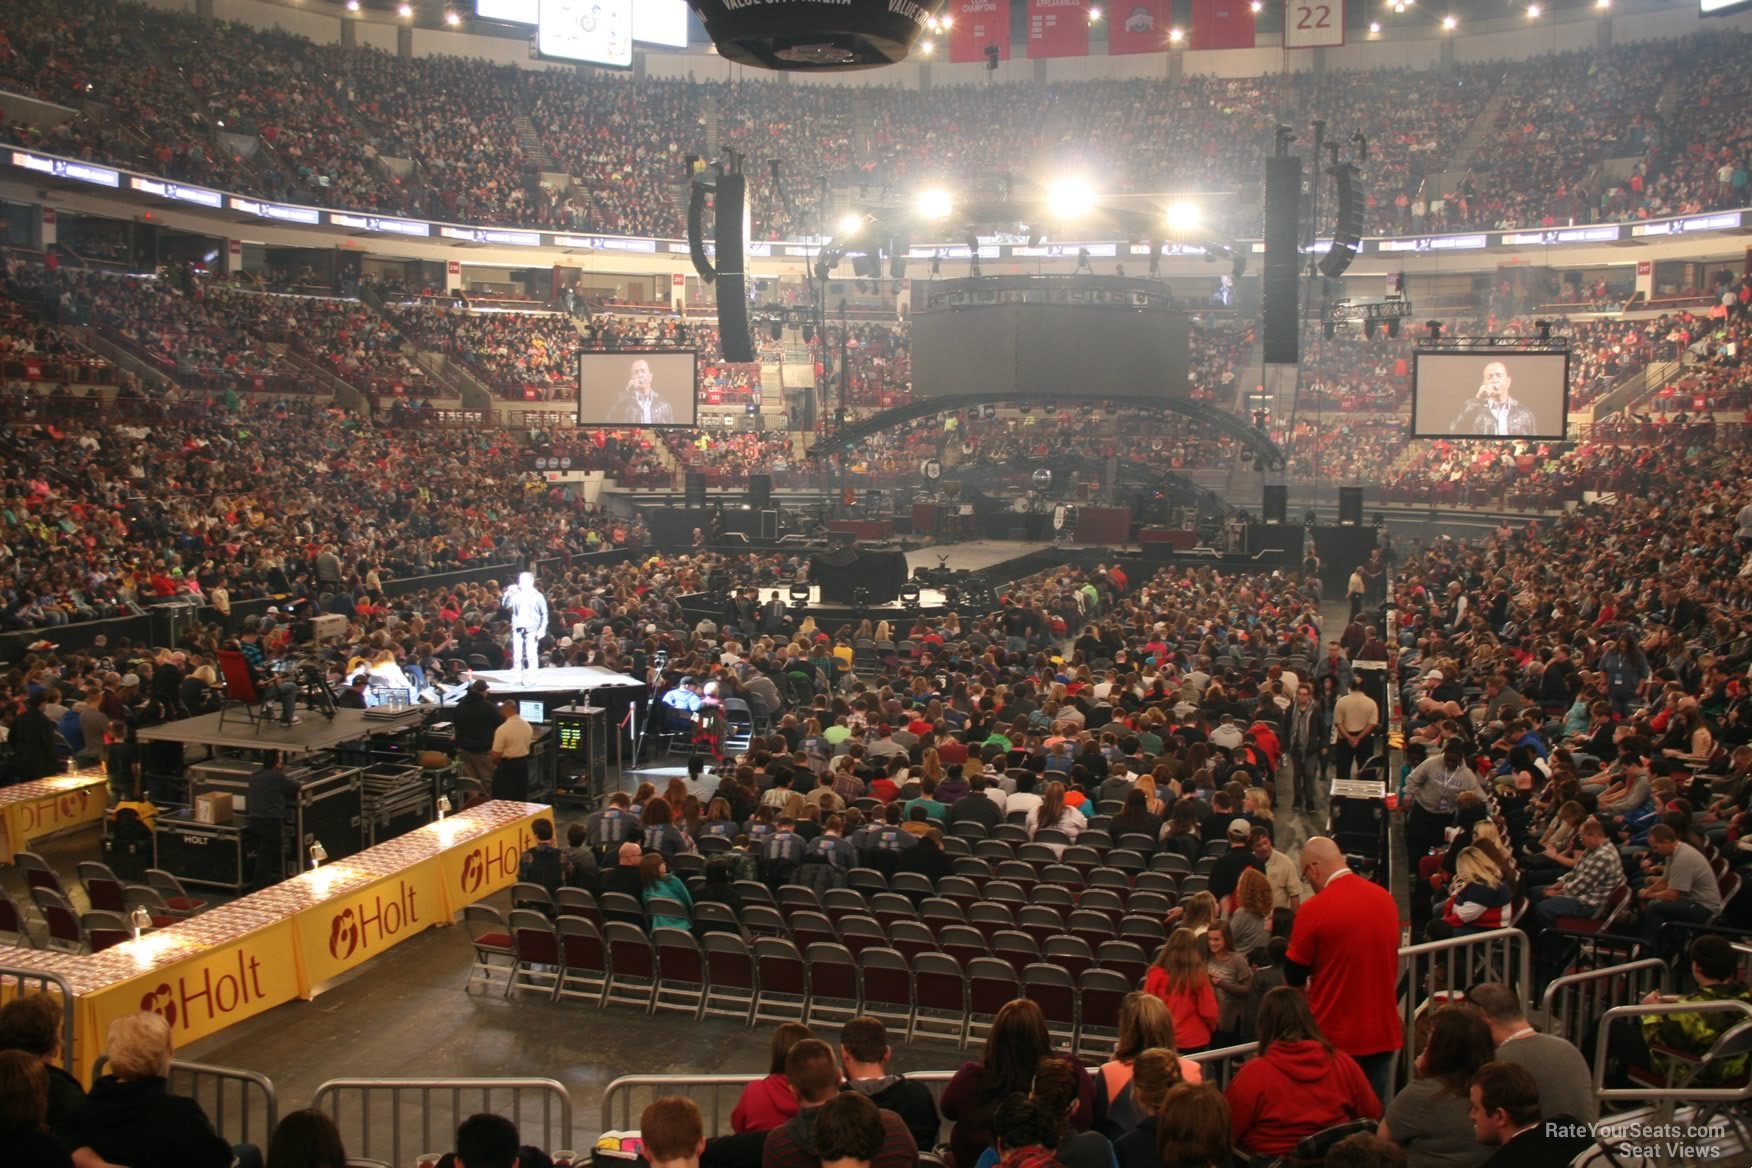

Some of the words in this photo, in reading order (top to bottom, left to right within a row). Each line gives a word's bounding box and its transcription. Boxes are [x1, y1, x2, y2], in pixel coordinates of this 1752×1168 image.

[888, 0, 919, 19] VALUE
[1297, 5, 1331, 30] 22
[184, 835, 209, 845] HOLT
[358, 880, 419, 948] Holt
[179, 949, 266, 1030] Holt
